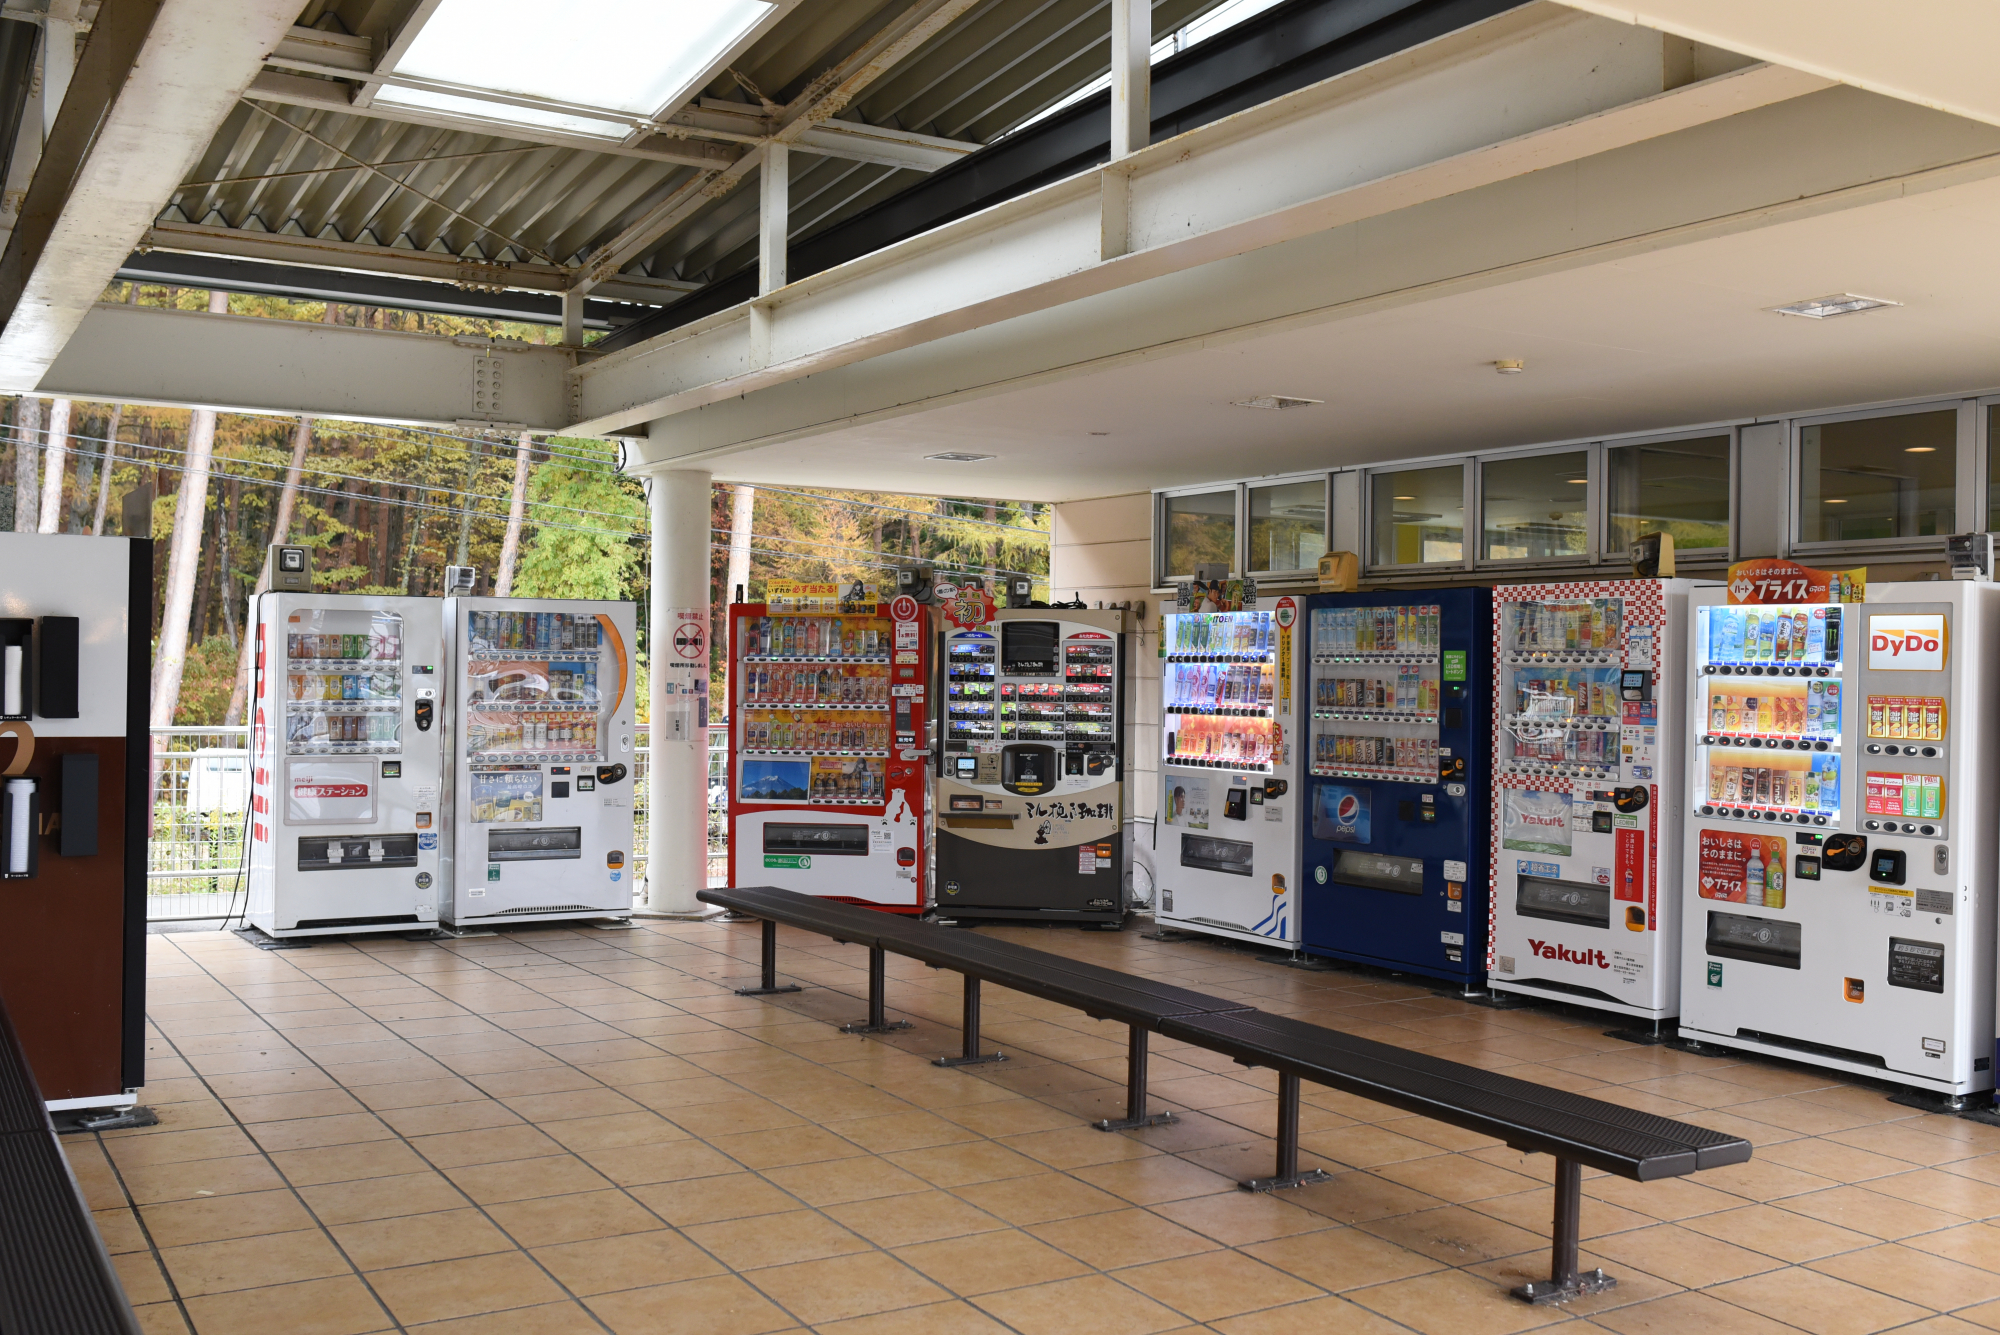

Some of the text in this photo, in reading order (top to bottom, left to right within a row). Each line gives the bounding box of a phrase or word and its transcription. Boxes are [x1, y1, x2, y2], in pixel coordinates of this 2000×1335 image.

[1736, 568, 1803, 576] おいしさはそのままに。
[792, 584, 838, 594] 必ず当たる!
[1734, 578, 1808, 600] ハート プライス
[1808, 585, 1826, 593] DyDo
[677, 612, 704, 620] 喫煙禁止
[953, 599, 986, 624] 初
[1354, 609, 1396, 619] SUNTORY
[1872, 635, 1939, 657] DyDo
[479, 774, 537, 783] 甘さに頼らない
[1521, 813, 1565, 828] Yakult
[1336, 825, 1356, 834] pepsi
[1702, 836, 1743, 849] おいしさは
[1702, 848, 1747, 862] そのままに。
[1530, 863, 1559, 873] 超省エネ
[1714, 878, 1742, 892] プライス
[1527, 938, 1611, 969] Yakult
